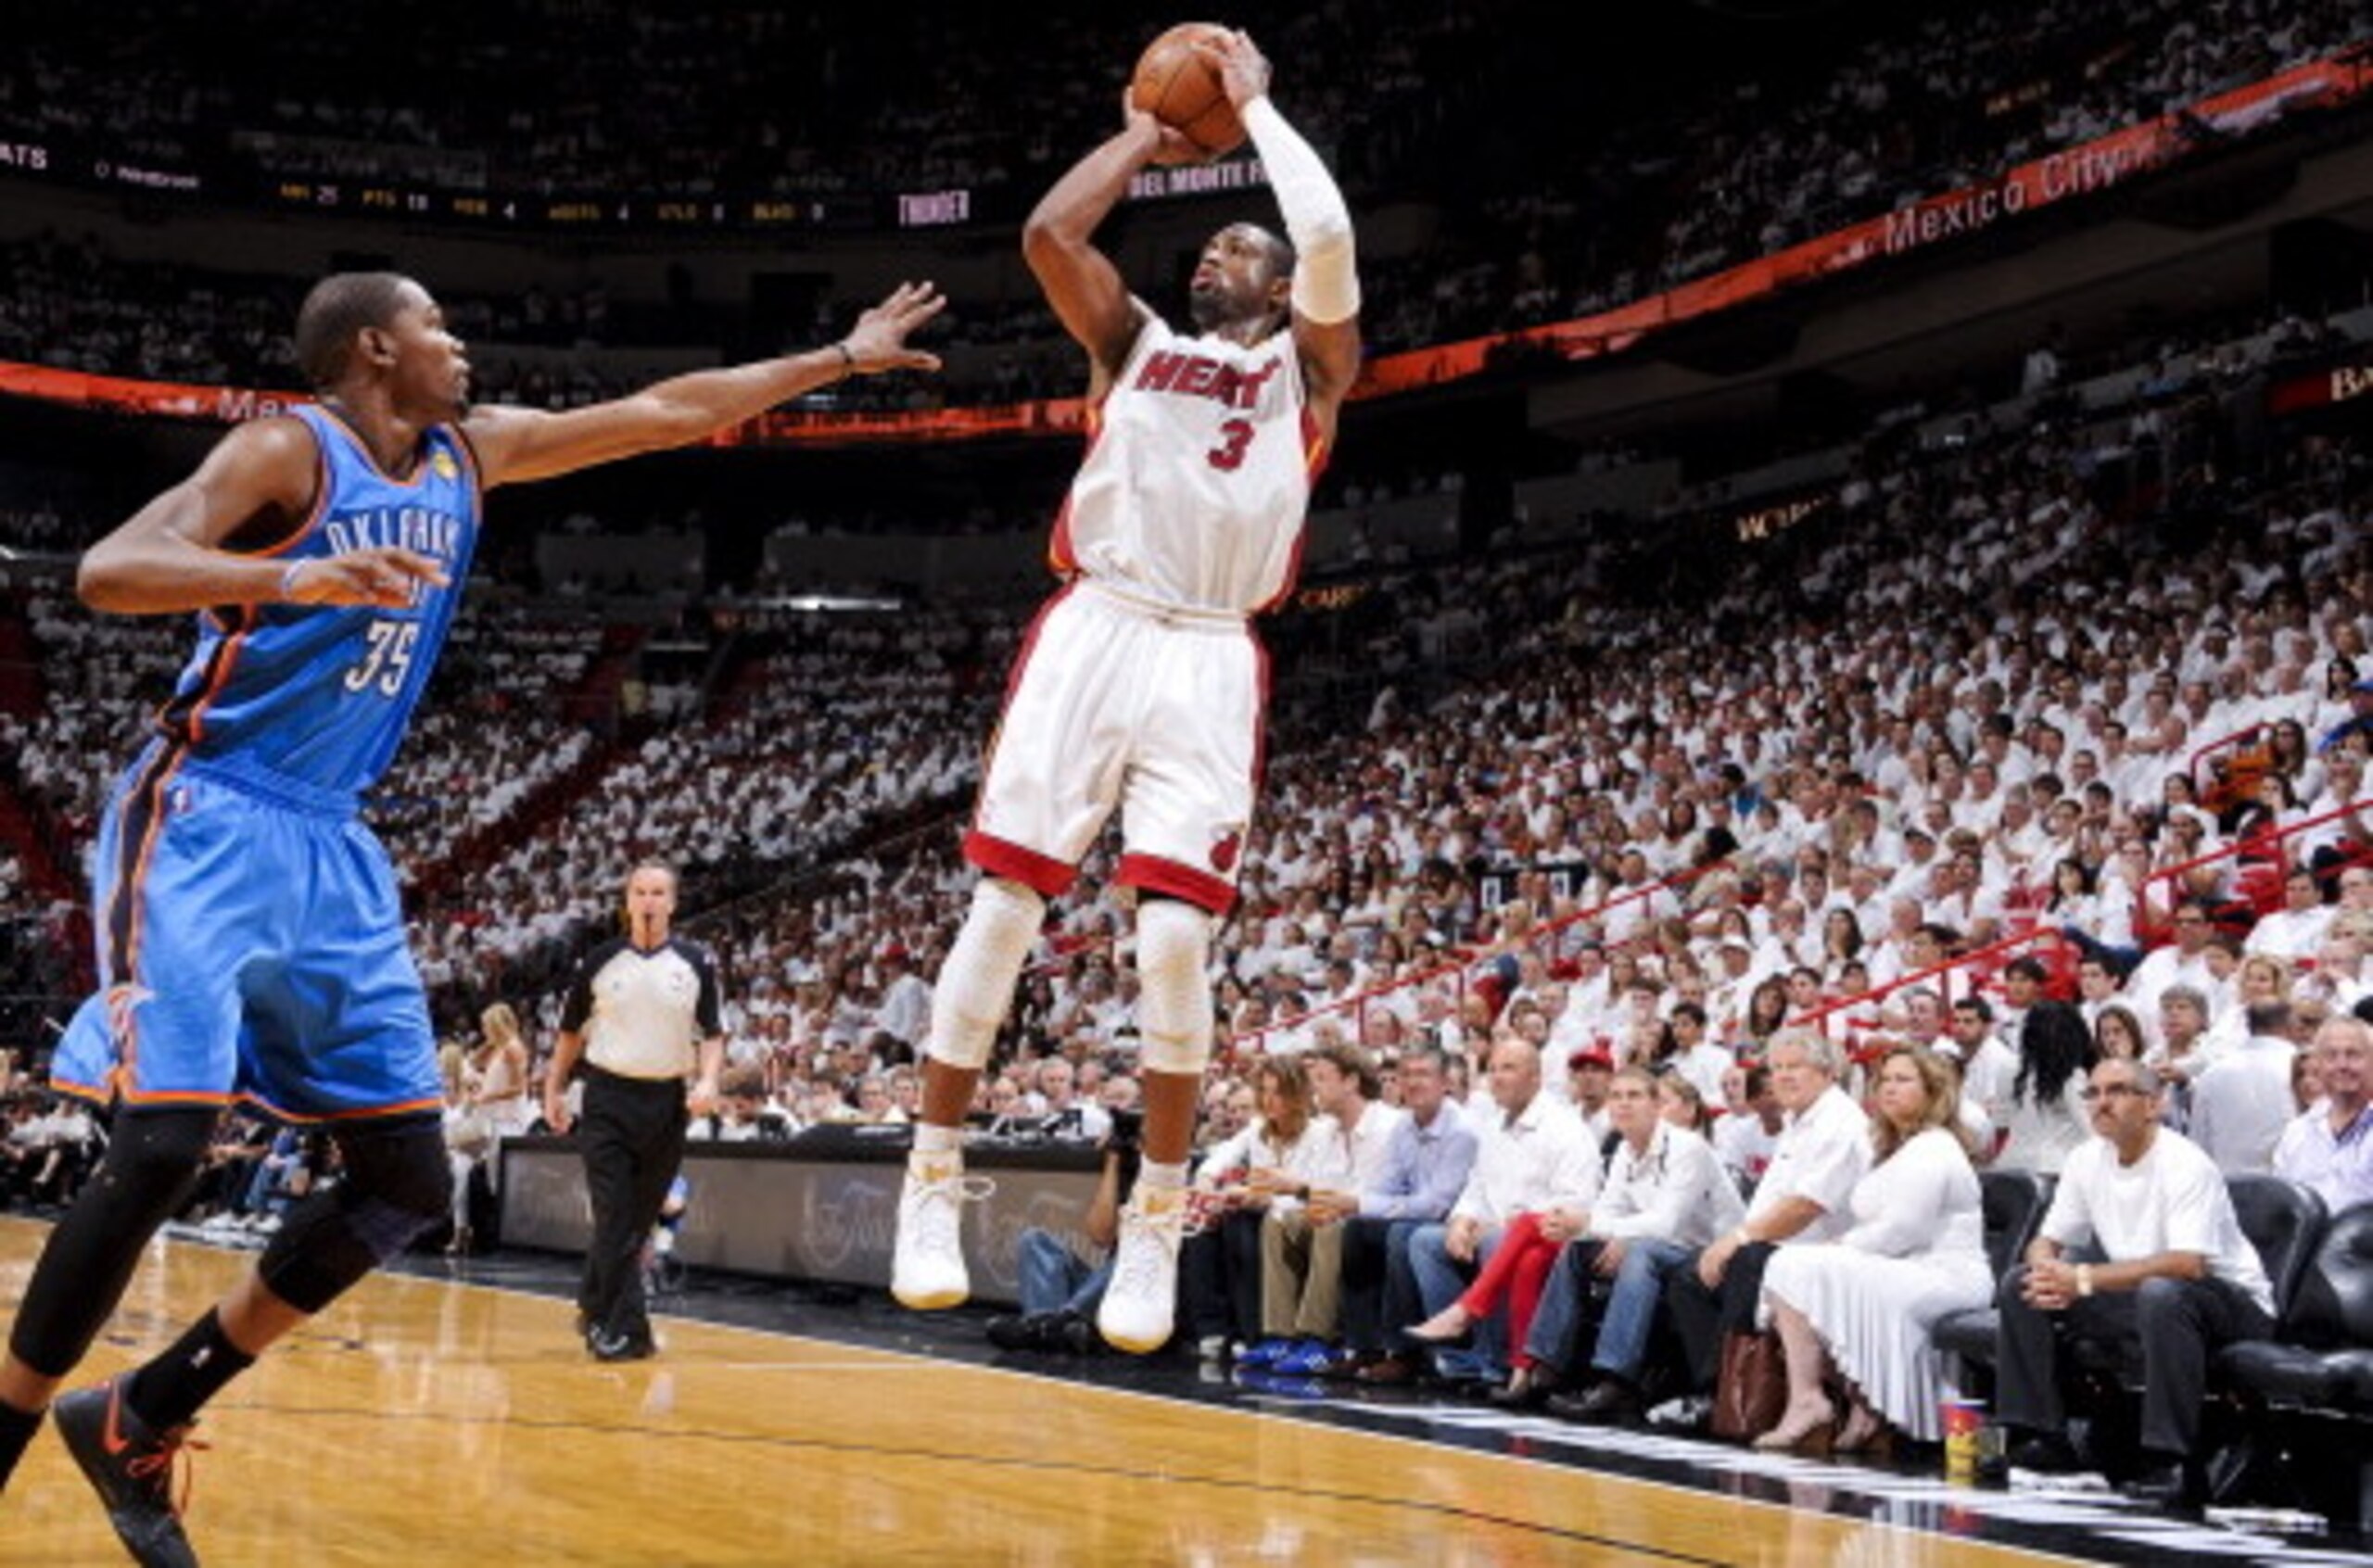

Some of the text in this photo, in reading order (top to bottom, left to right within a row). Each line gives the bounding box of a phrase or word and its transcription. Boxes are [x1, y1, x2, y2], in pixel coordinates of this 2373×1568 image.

[1169, 161, 1244, 194] MONTE
[1884, 183, 2025, 256] Mexico
[2040, 150, 2117, 201] City
[1135, 348, 1284, 409] HEAT
[1206, 418, 1255, 472] 3
[344, 619, 421, 697] 35
